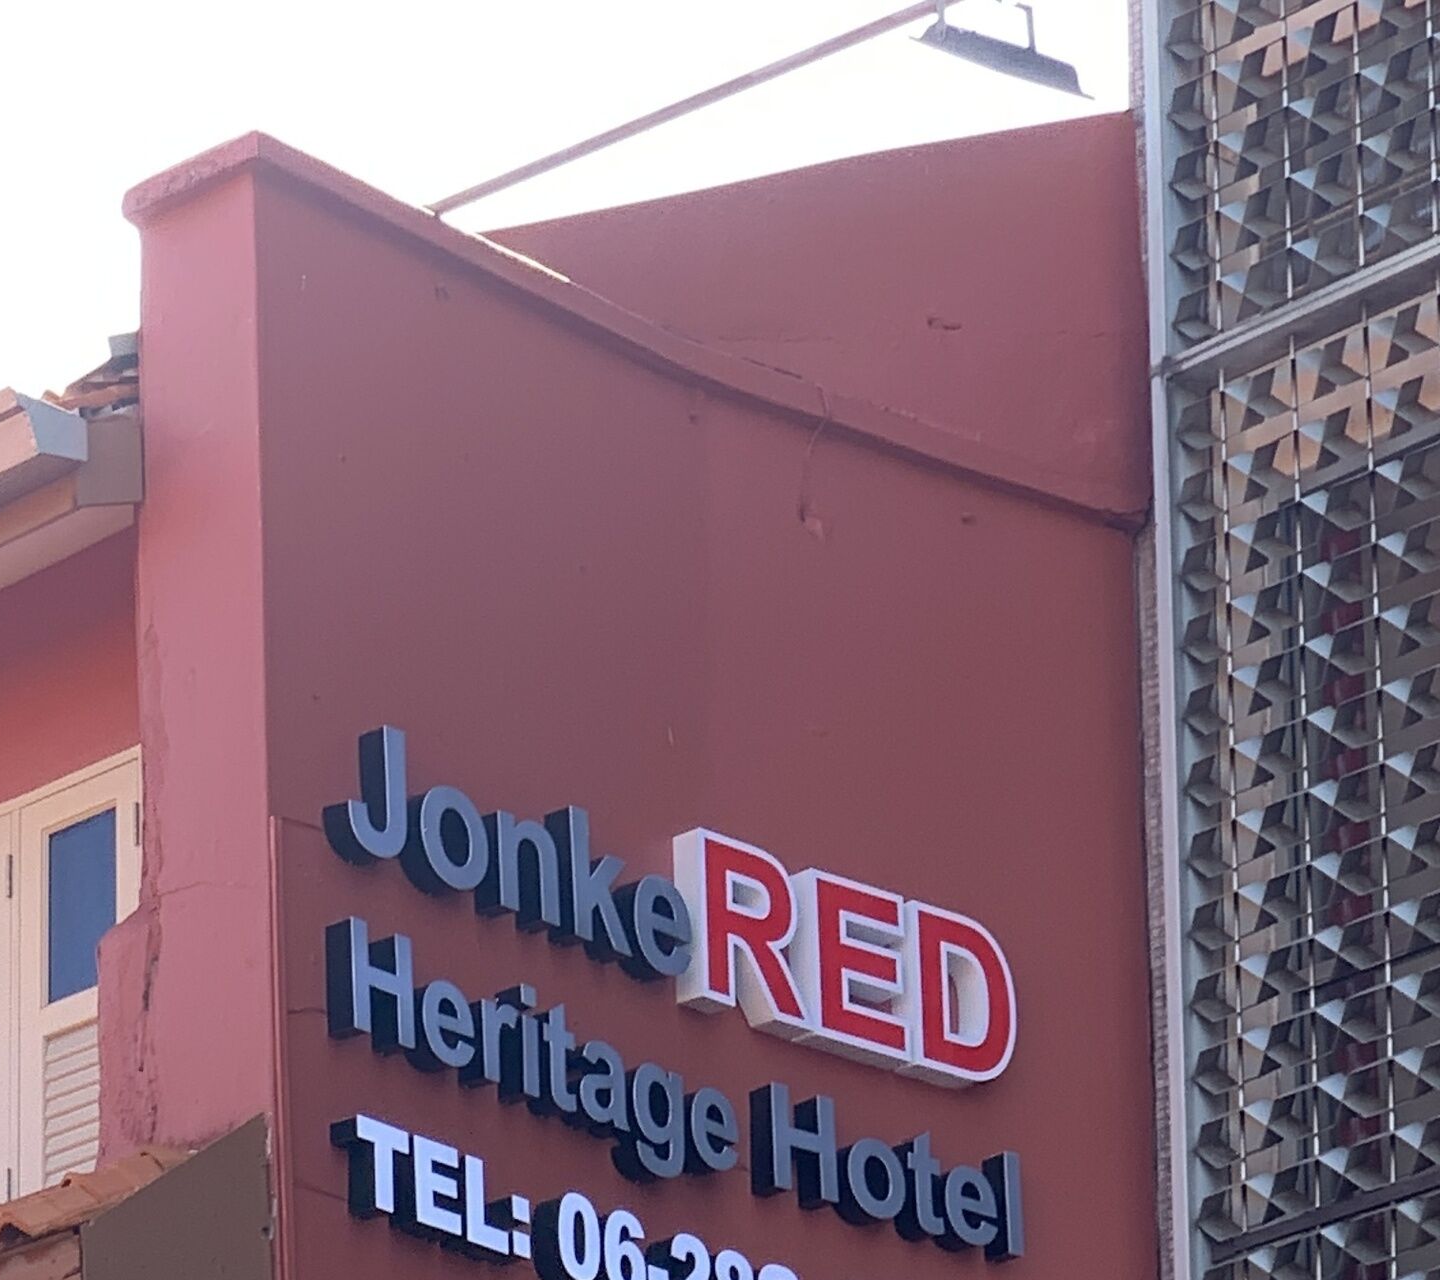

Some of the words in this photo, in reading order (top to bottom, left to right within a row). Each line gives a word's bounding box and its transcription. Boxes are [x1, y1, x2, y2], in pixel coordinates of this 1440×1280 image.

[350, 724, 1017, 1083] JonkeRED
[350, 916, 739, 1178] Heritage
[768, 1082, 1026, 1257] Hotel
[356, 1113, 532, 1260] TEL:
